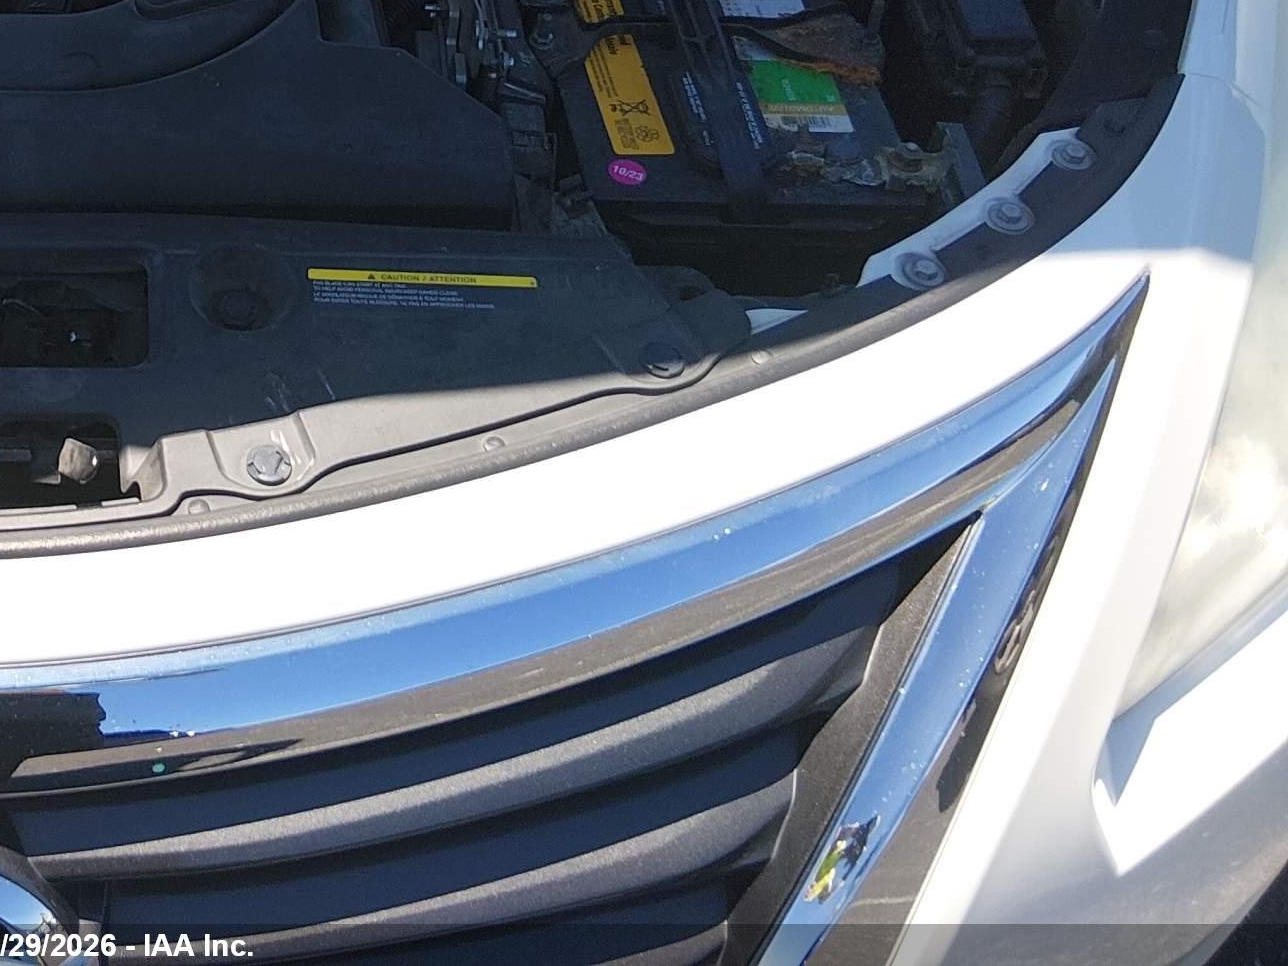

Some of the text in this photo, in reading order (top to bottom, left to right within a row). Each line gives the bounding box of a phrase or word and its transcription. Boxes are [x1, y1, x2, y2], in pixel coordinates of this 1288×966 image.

[613, 165, 644, 182] 10/23
[380, 273, 420, 281] CAUTION
[429, 275, 477, 283] ATTENTION
